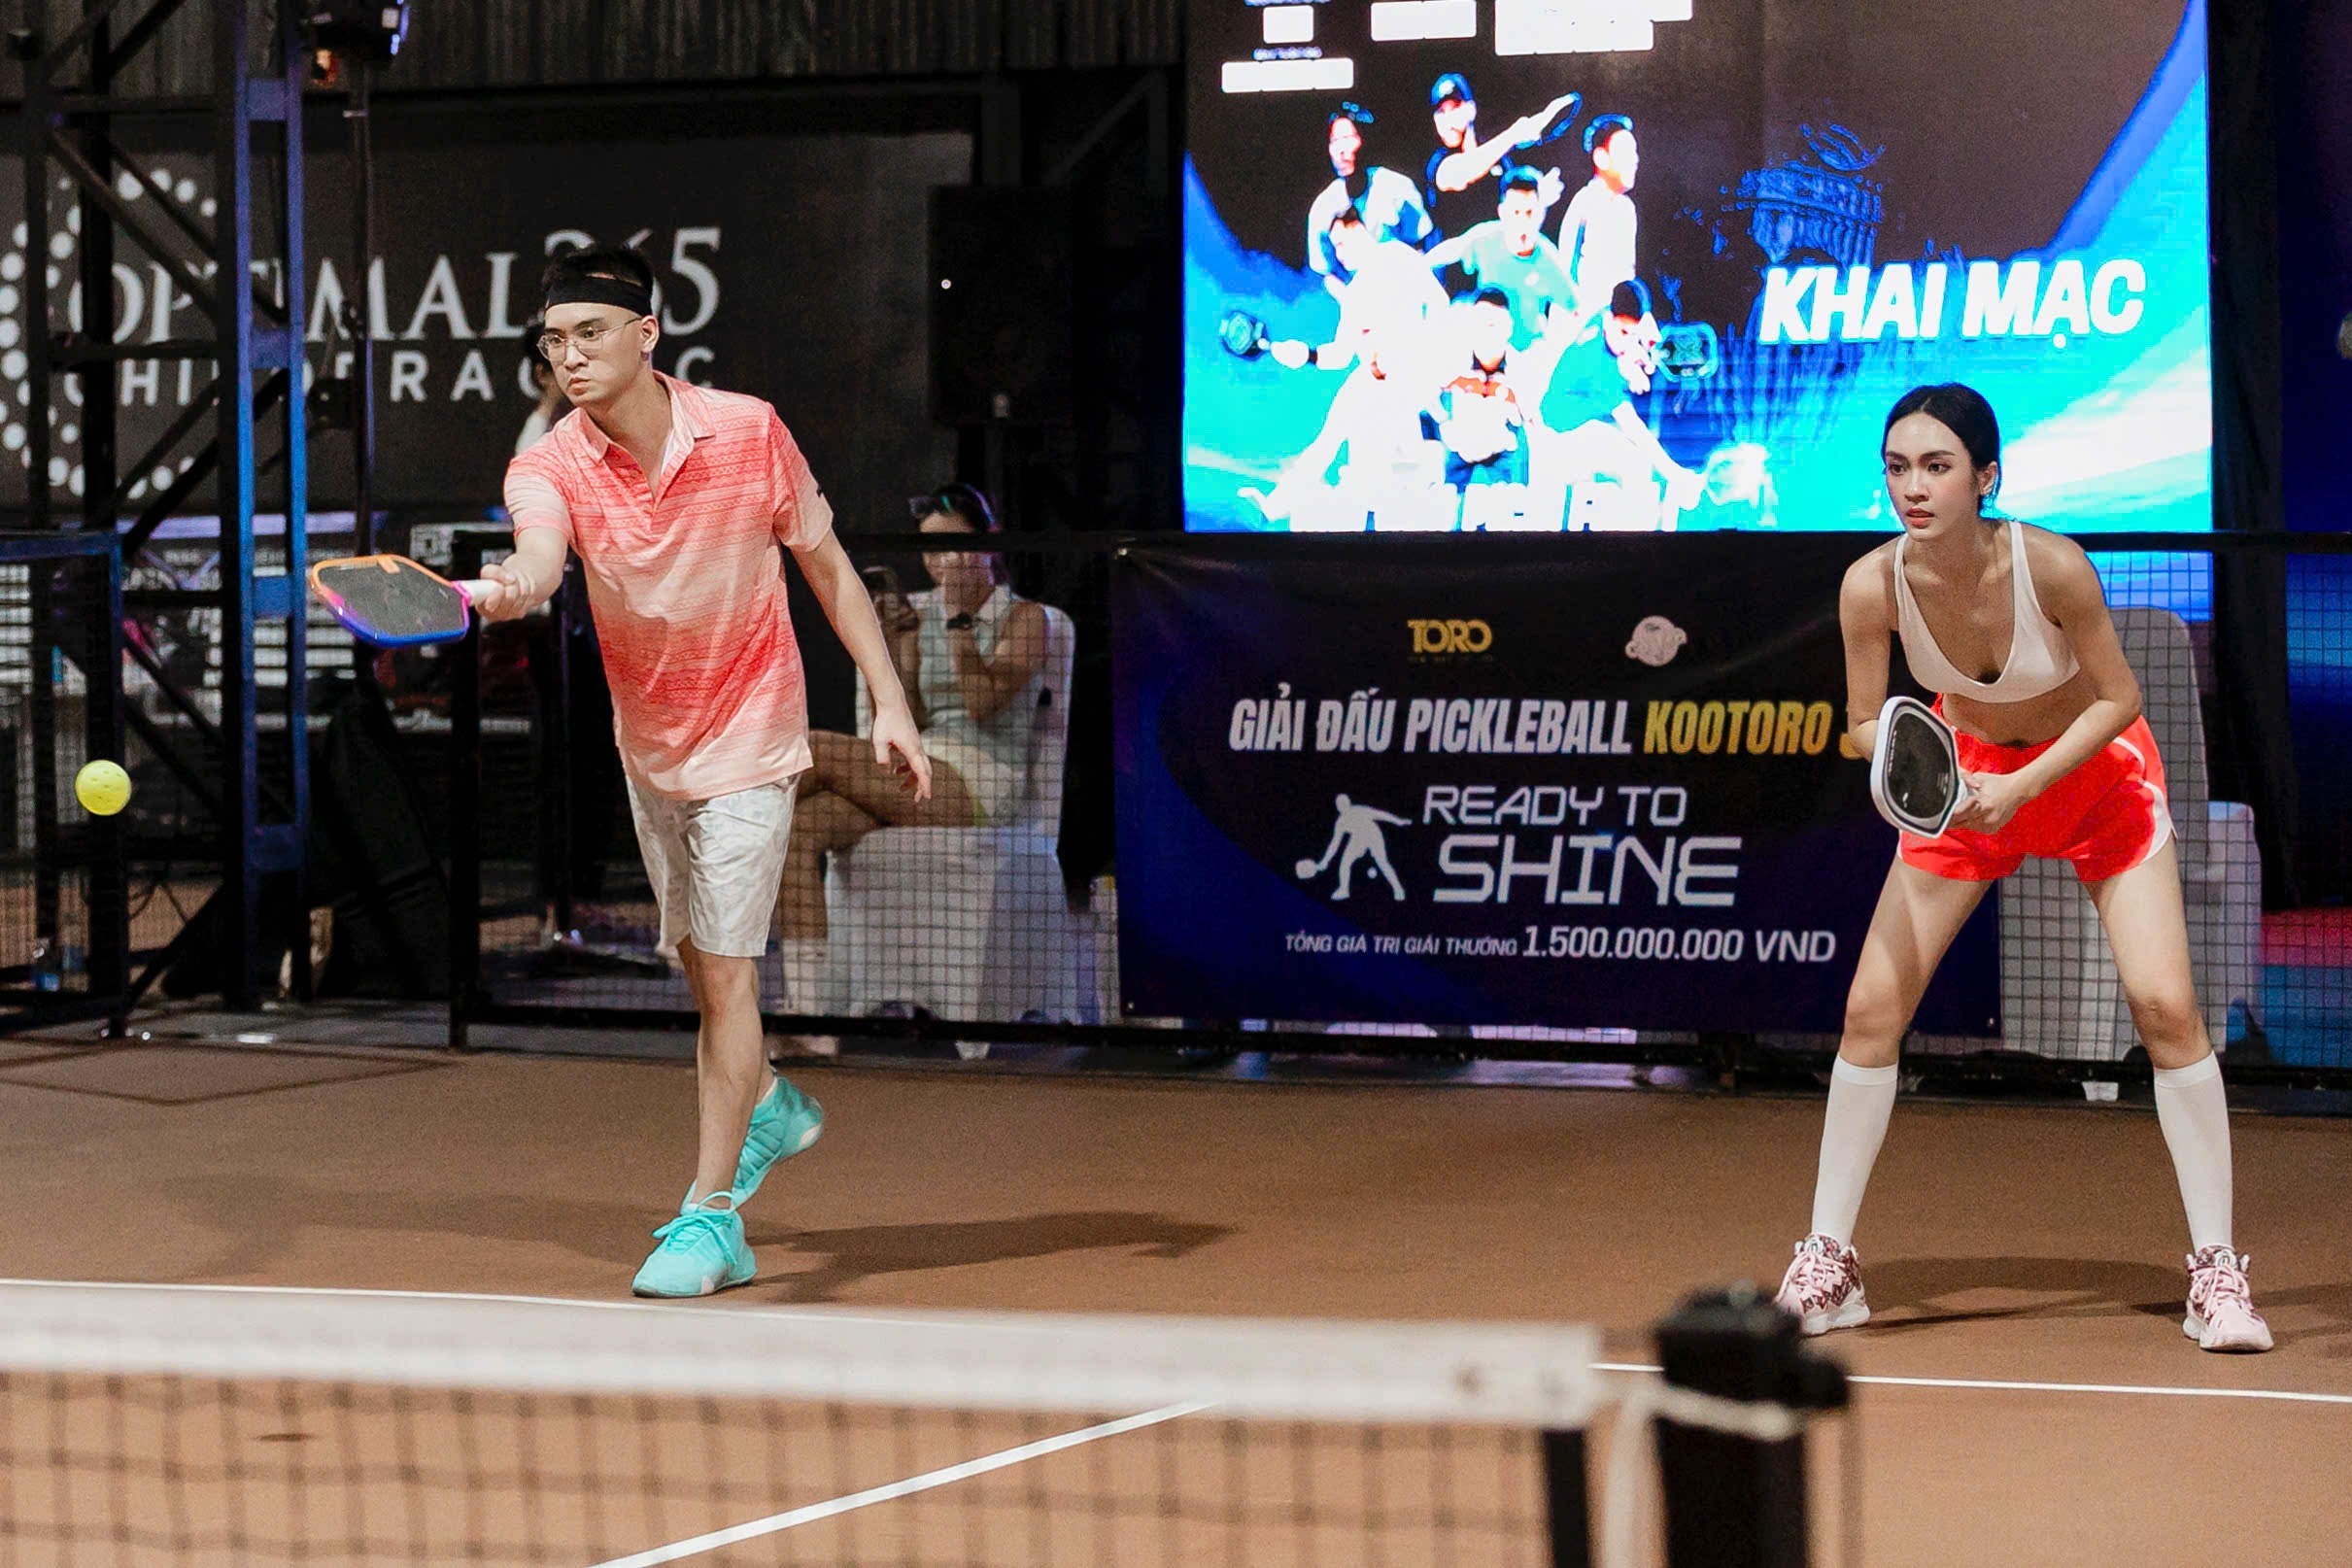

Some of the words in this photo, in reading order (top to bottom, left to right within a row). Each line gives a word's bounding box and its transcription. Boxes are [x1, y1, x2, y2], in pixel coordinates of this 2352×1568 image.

[1758, 262, 1949, 344] KHAI
[1961, 258, 2147, 350] MẠC
[1407, 619, 1493, 653] TORO
[1228, 681, 1307, 752] GIẢI
[1314, 687, 1397, 753] ĐẤU
[1403, 699, 1633, 755] PICKLEBALL
[1643, 700, 1833, 756] KOOTORO
[1422, 786, 1604, 826] READY
[1618, 786, 1687, 827] TO
[1433, 834, 1742, 906] SHINE
[1522, 925, 1745, 961] 1.500.000.000
[1755, 930, 1837, 962] VND
